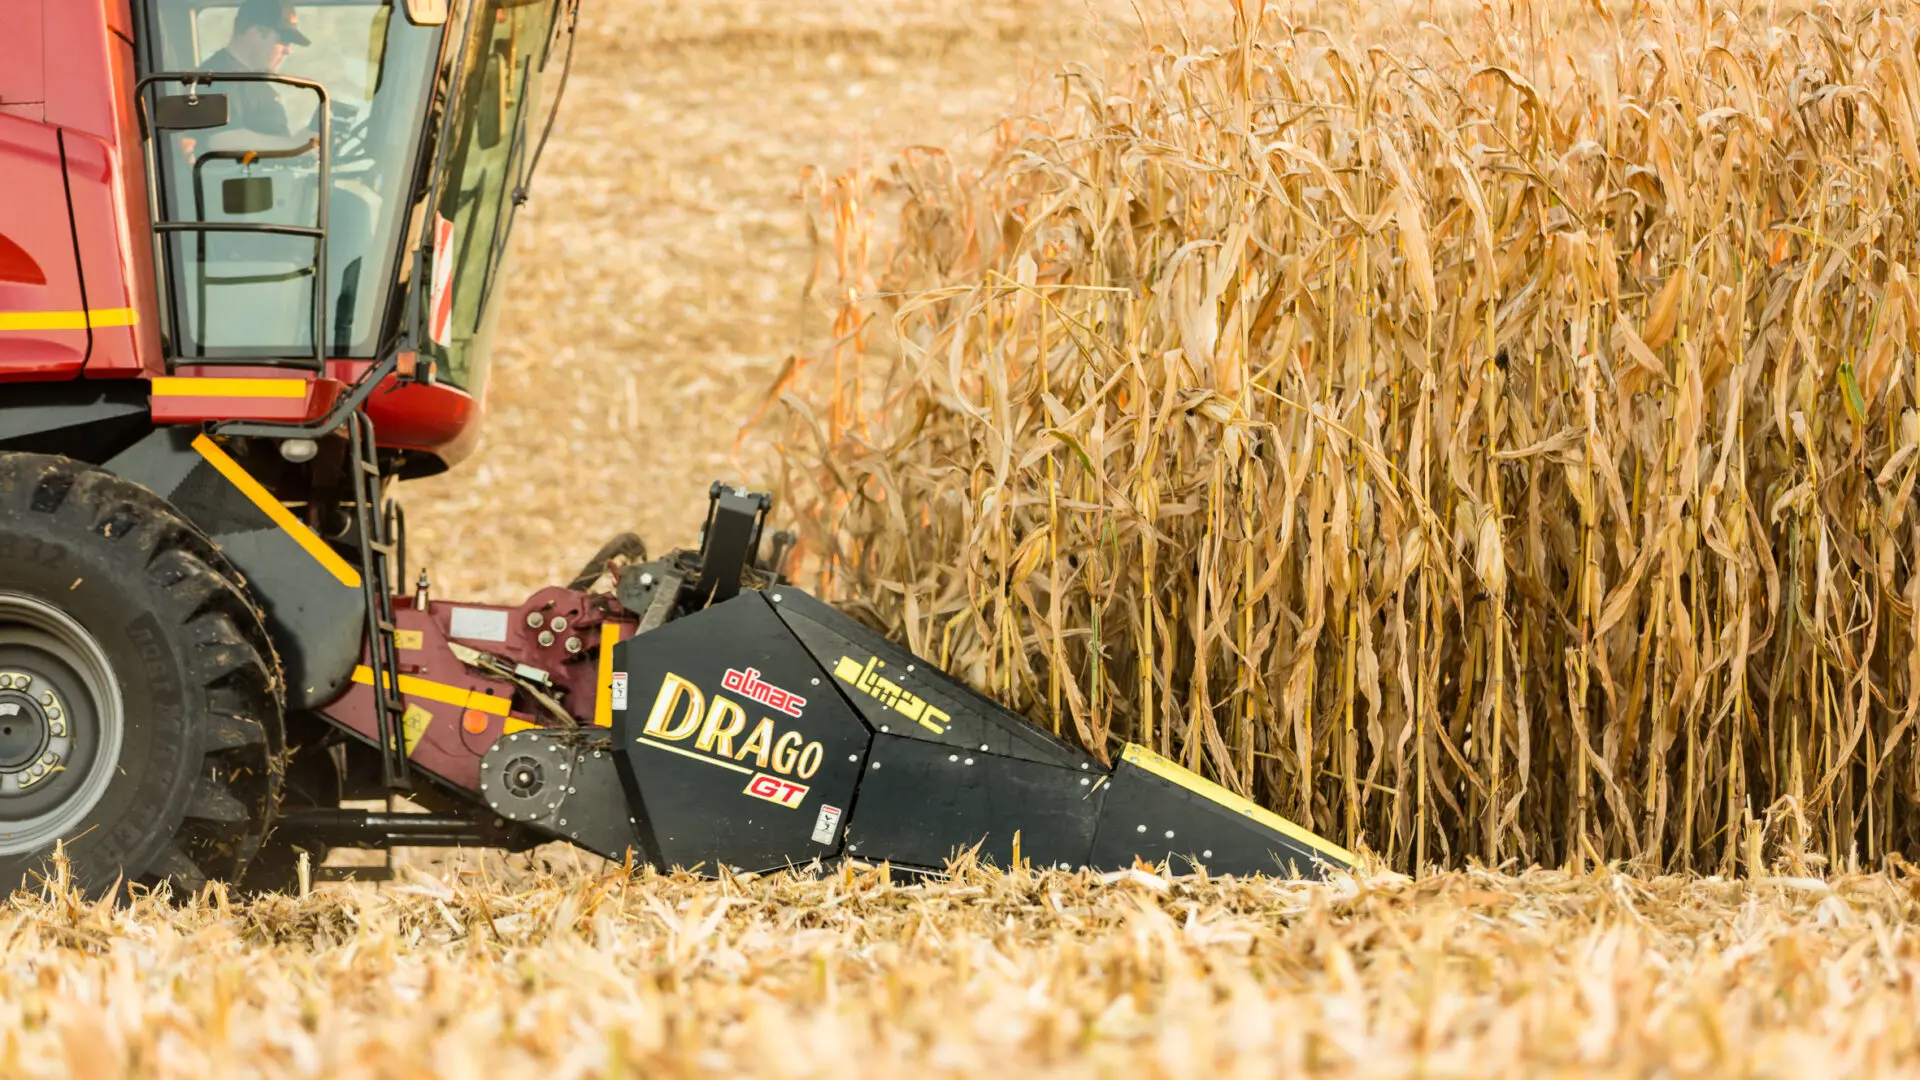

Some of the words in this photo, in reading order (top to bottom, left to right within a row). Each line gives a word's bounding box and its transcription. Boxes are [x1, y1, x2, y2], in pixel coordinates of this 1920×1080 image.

[722, 668, 806, 717] olimac
[643, 672, 824, 780] DRAGO
[750, 775, 806, 803] GT
